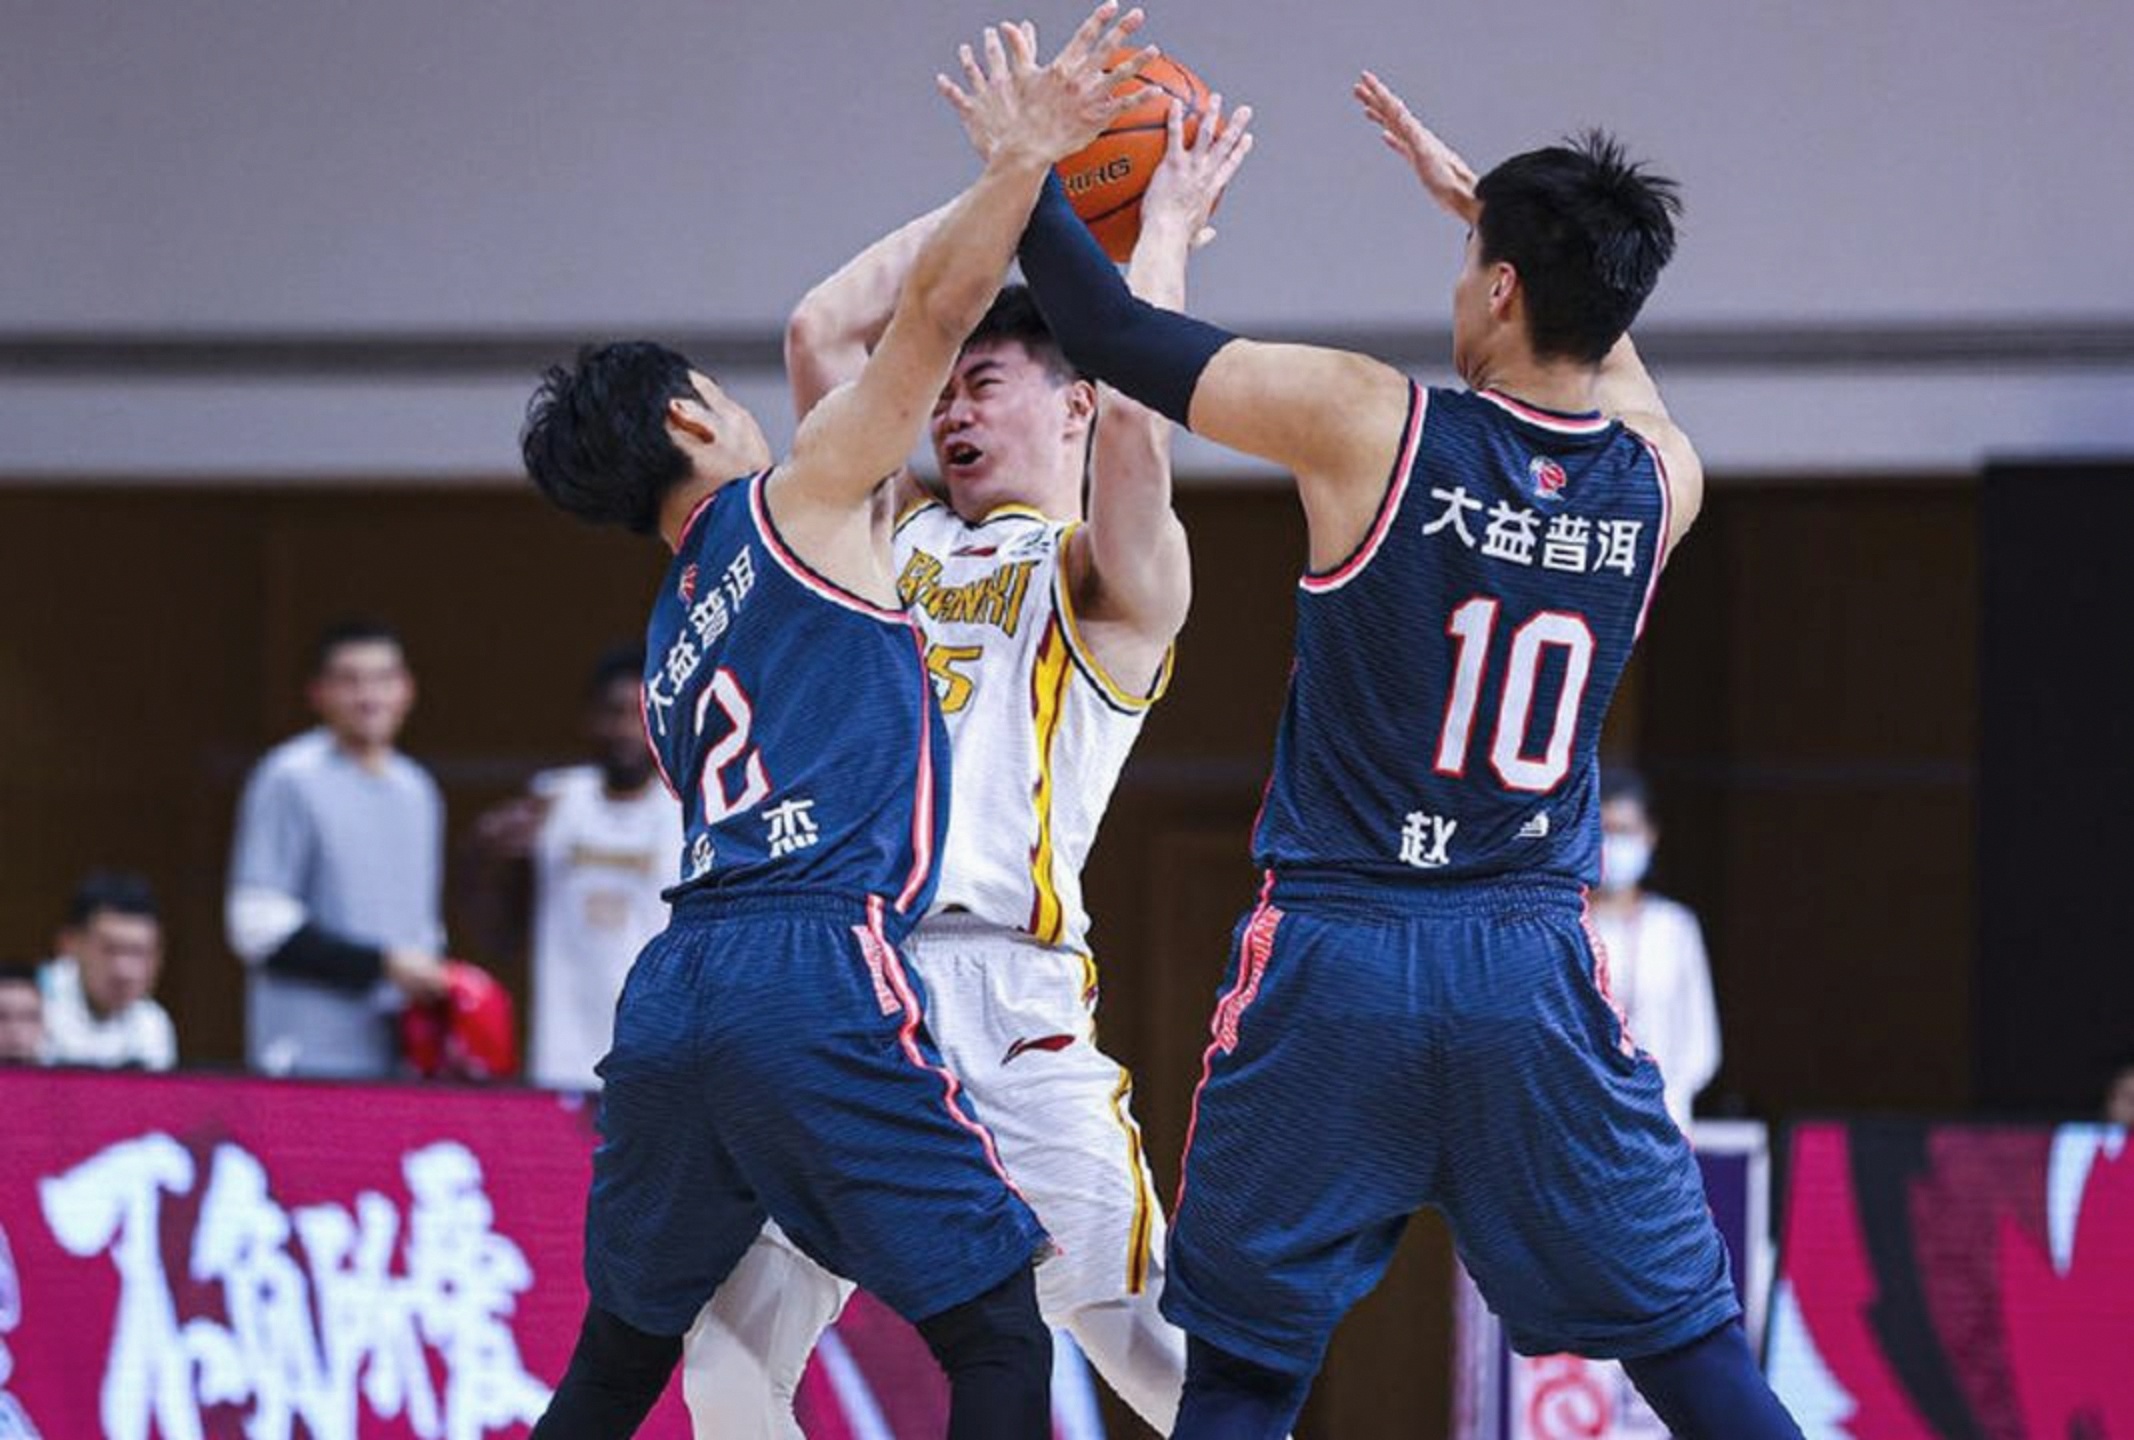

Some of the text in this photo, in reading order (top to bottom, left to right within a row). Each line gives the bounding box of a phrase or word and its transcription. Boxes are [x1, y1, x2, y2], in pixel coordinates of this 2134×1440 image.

[1422, 486, 1643, 577] 大益普洱
[646, 544, 756, 737] 大益普洱
[1433, 597, 1595, 793] 10
[694, 666, 772, 825] 2
[1399, 810, 1458, 868] 赵
